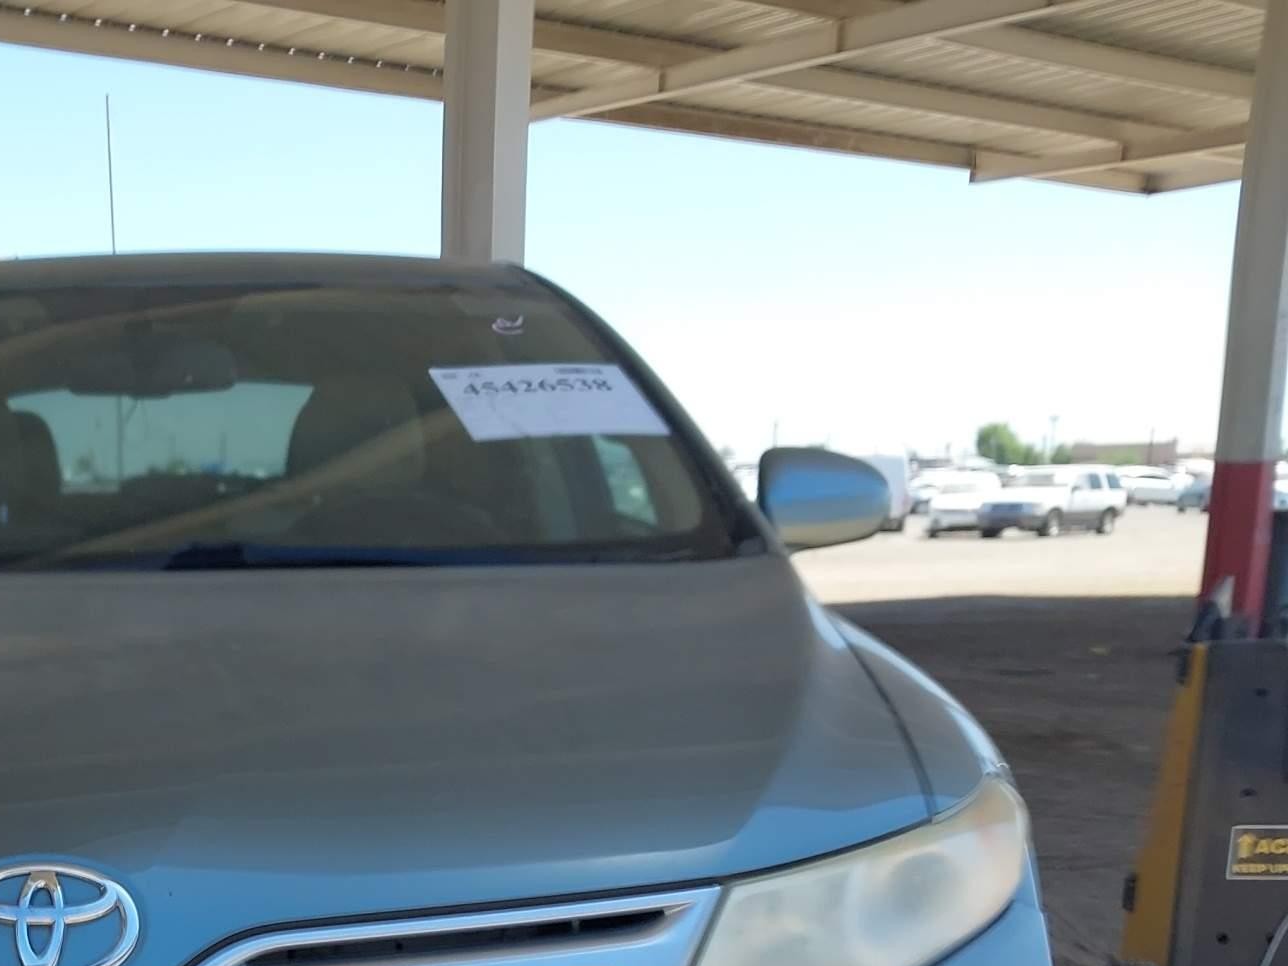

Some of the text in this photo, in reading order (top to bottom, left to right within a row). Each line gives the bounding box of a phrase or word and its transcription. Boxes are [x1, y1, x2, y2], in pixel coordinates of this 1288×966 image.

[463, 377, 613, 396] 45426538
[1254, 837, 1288, 855] AC
[1270, 863, 1288, 874] UP
